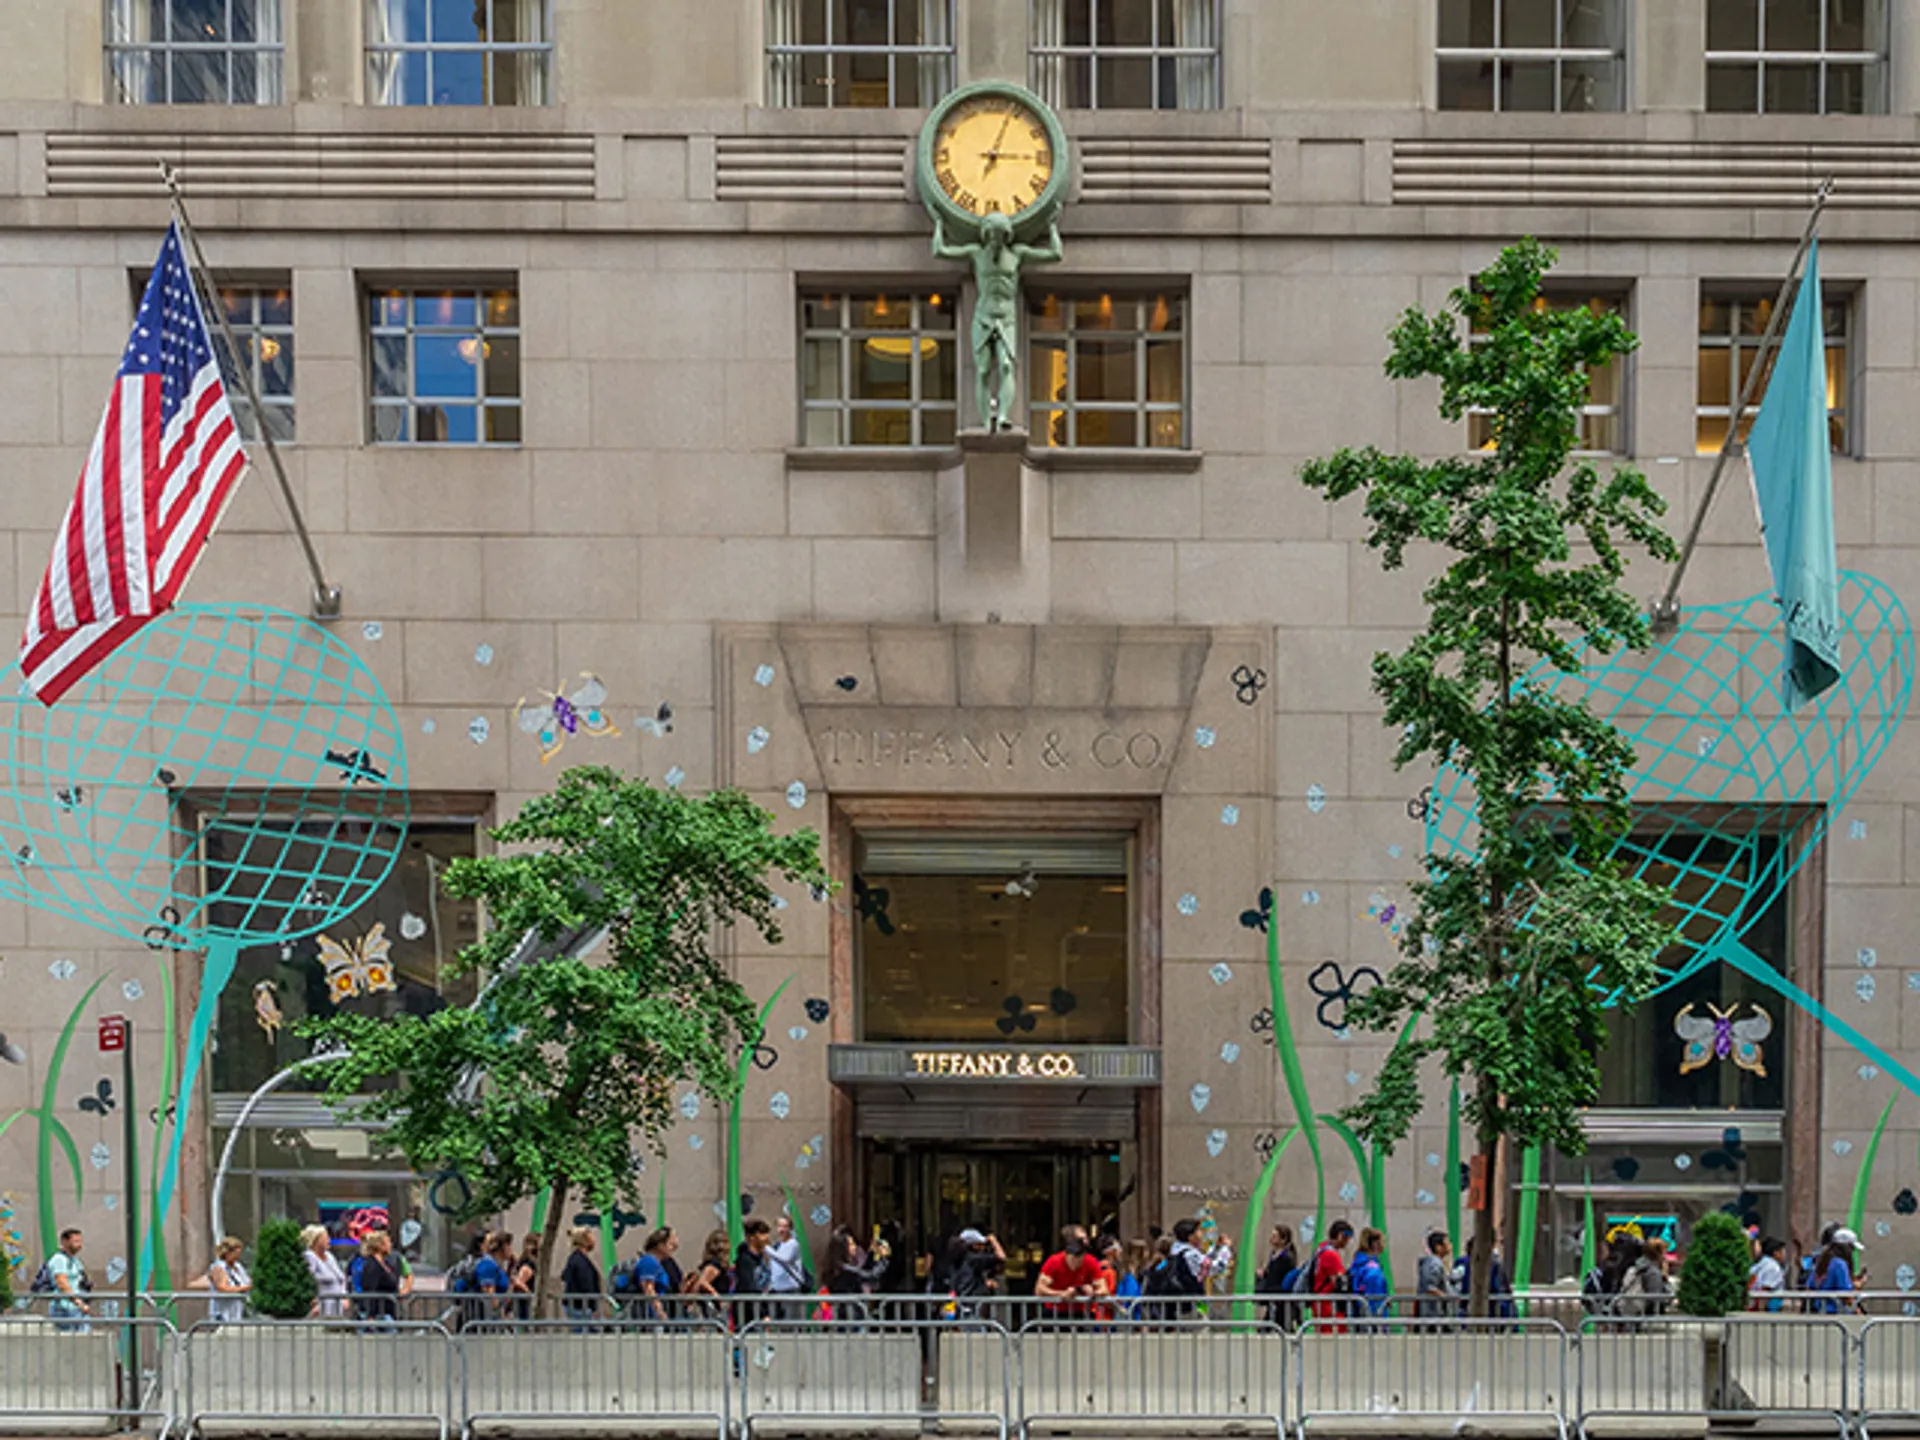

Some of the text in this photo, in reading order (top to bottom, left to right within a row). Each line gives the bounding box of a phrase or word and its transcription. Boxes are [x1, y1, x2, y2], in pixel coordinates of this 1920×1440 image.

[820, 728, 1023, 768] TIFFANY
[1040, 731, 1070, 769] &
[912, 1052, 1078, 1076] TIFFANY & CO.
